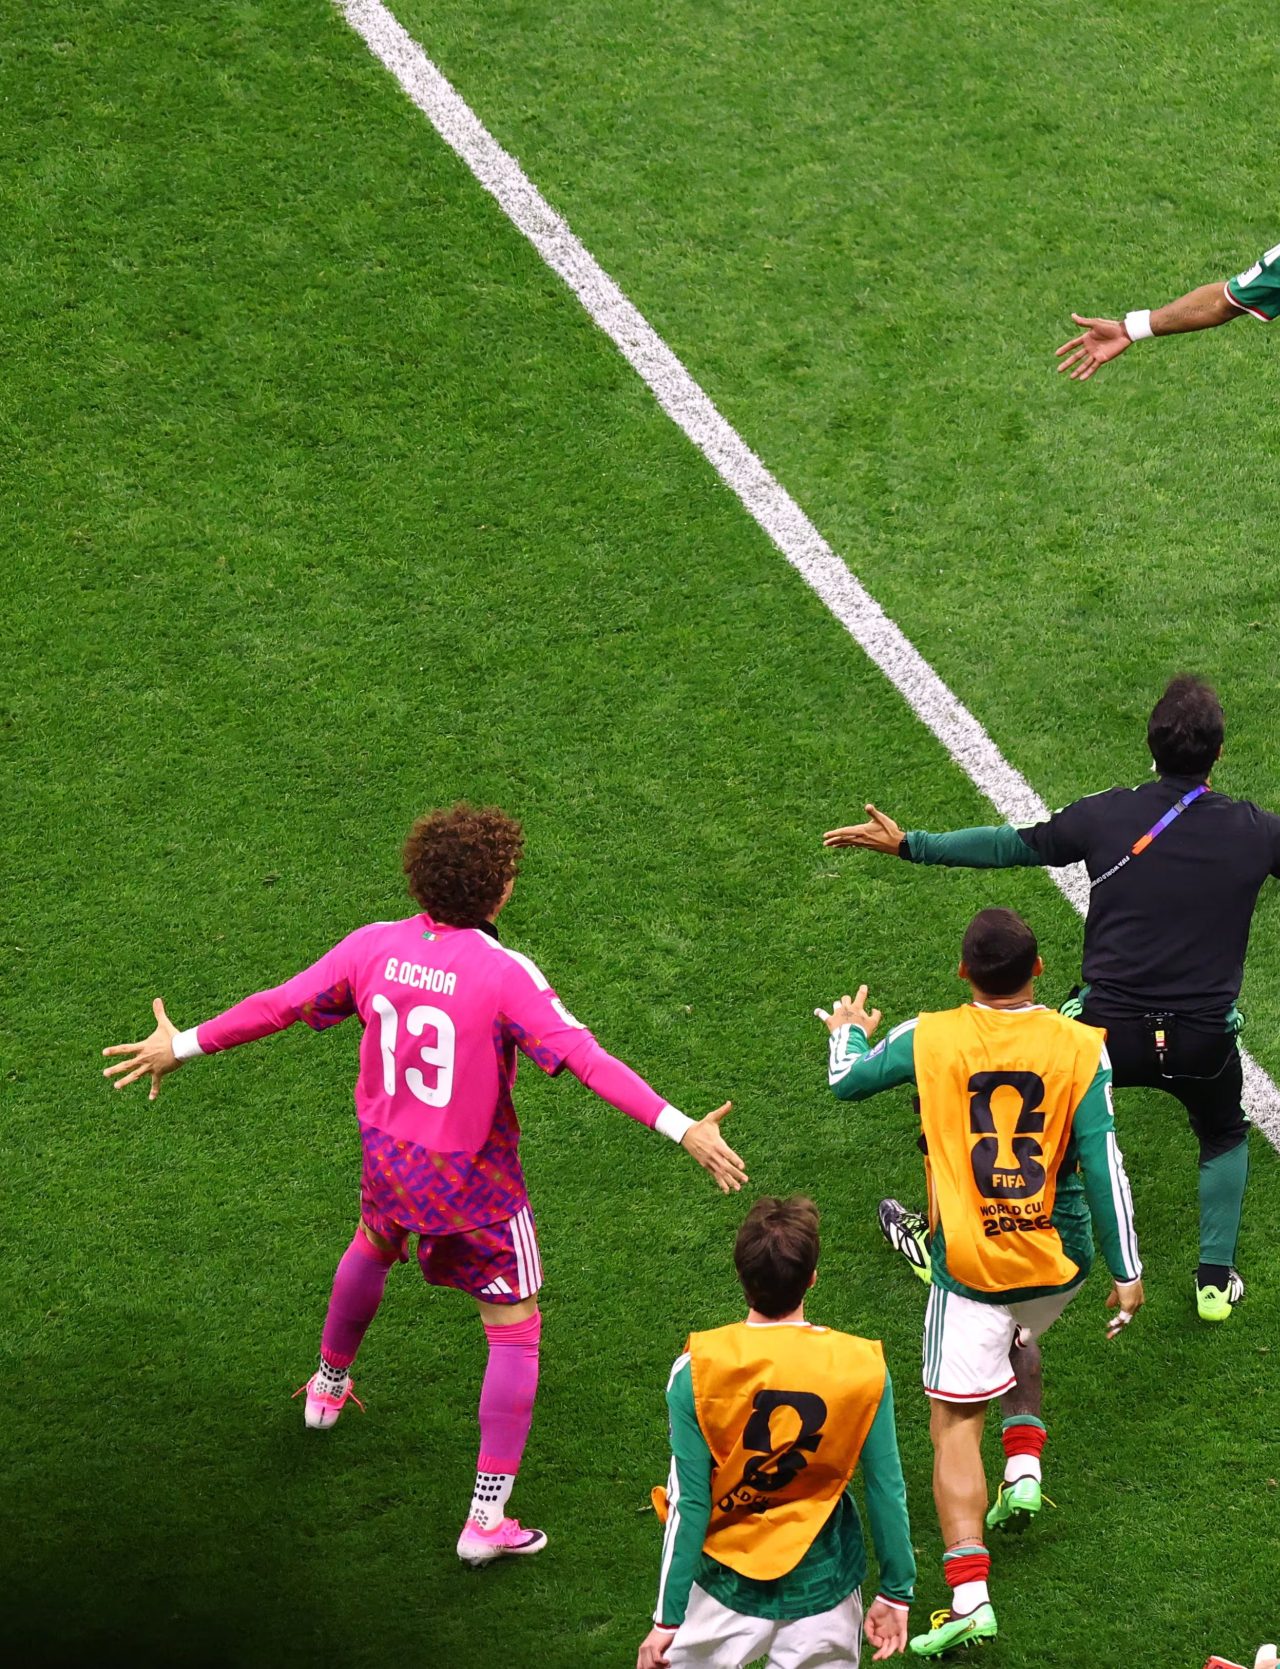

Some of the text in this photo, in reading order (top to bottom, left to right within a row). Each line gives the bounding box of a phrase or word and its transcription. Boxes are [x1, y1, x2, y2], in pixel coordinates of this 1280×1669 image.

[384, 957, 457, 996] G.OCHOA
[371, 993, 456, 1108] 13
[992, 1173, 1026, 1189] FIFA
[980, 1204, 1021, 1217] WORLD
[983, 1214, 1054, 1238] 2026
